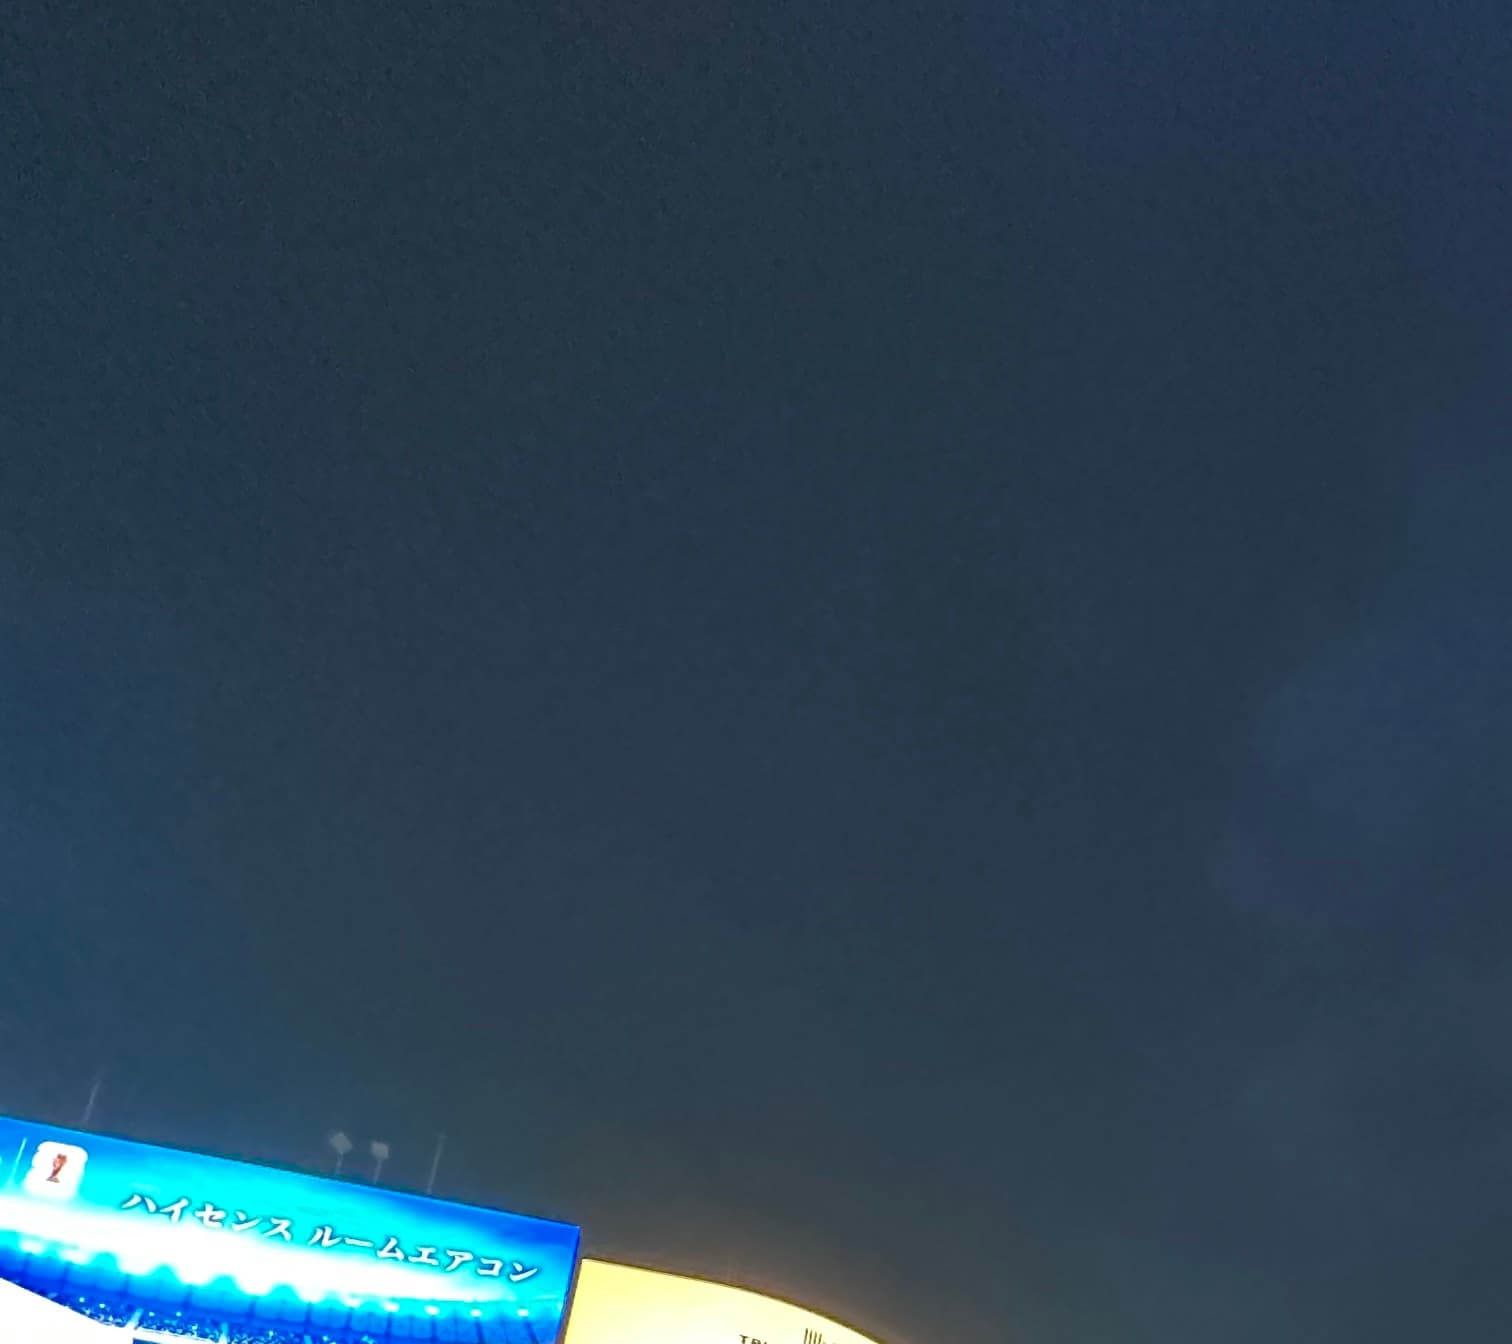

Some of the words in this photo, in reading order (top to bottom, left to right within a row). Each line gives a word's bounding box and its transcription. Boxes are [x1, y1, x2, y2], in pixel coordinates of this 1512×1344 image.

[121, 1192, 293, 1242] ハイセンス
[308, 1225, 539, 1283] ルームエアコン
